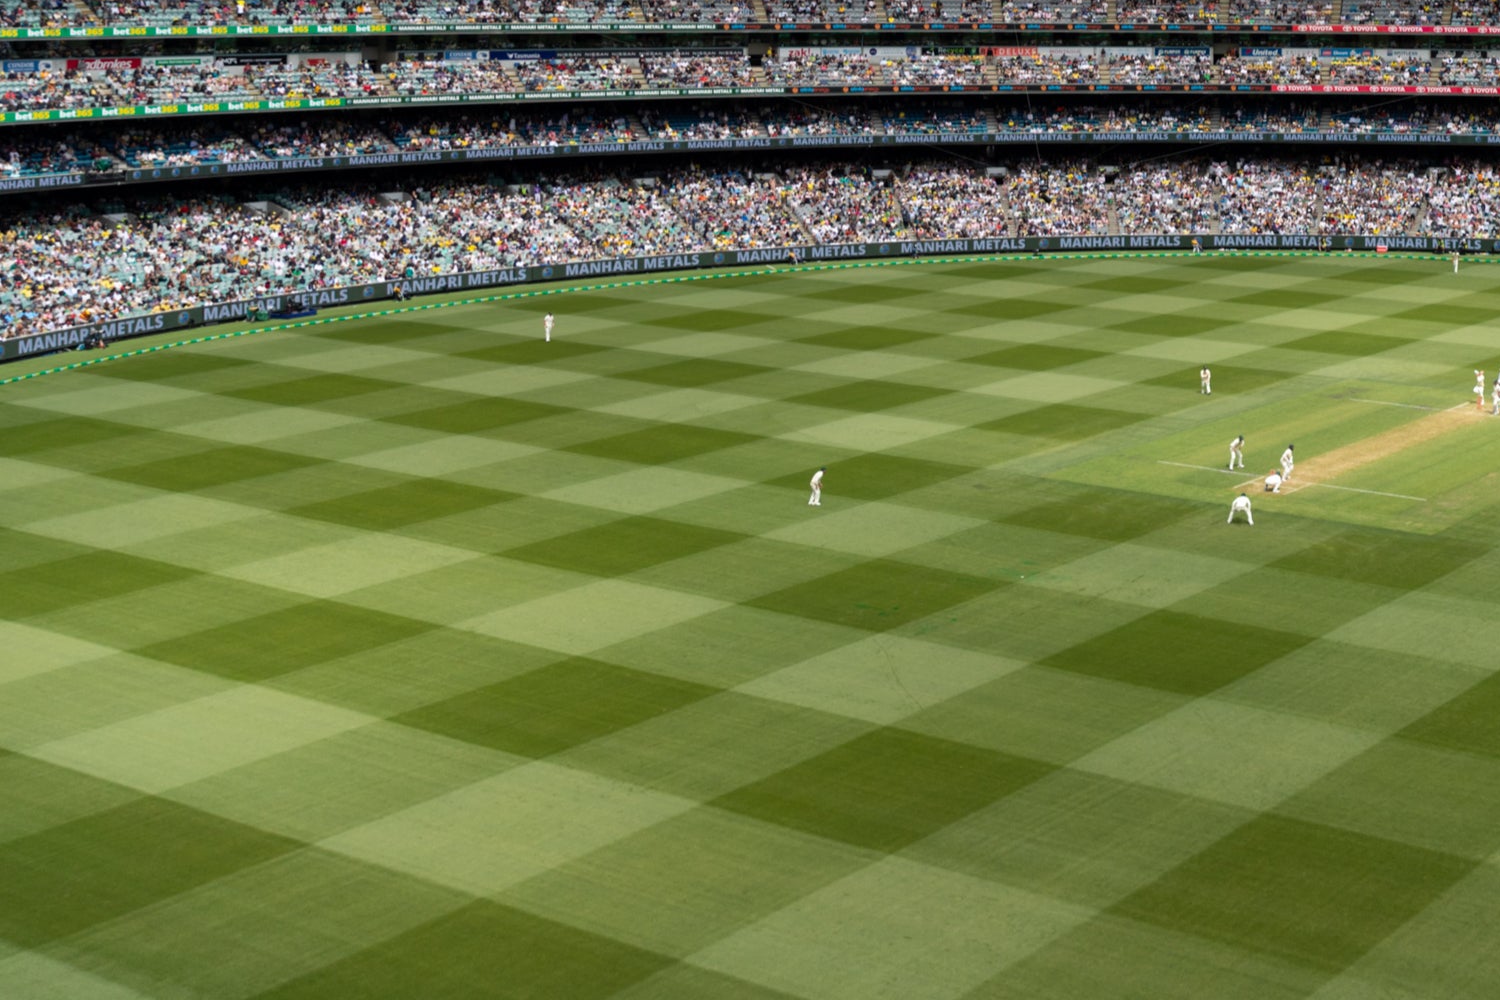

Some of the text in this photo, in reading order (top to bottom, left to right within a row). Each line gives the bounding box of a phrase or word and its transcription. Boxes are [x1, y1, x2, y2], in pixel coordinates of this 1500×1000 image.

[15, 112, 49, 120] bet365
[59, 110, 92, 118] bet365
[102, 108, 135, 116] bet365
[793, 136, 873, 145] MANHARI METALS
[896, 134, 974, 143] MANHARI METALS
[995, 133, 1072, 141] MANHARI METALS
[1093, 132, 1168, 141] MANHARI METALS
[1189, 133, 1263, 141] MANHARI METALS
[1284, 133, 1357, 141] MANHARI METALS
[1377, 134, 1450, 143] MANHARI METALS
[579, 141, 664, 153] MANHARI METALS
[688, 138, 771, 149] MANHARI METALS
[466, 147, 555, 158] MANHARI METALS
[349, 153, 441, 165] MANHARI METALS
[227, 159, 323, 172] MANHARI METALS
[0, 176, 81, 189] NHARI METALS
[901, 239, 1025, 253] MANHARI METALS
[1060, 236, 1180, 247] MANHARI METALS
[1214, 236, 1332, 246] MANHARI METALS
[1365, 237, 1482, 249] MANHARI METLS
[737, 245, 866, 262] MANHARI METALS
[566, 255, 699, 276] MANHARI METALS
[387, 270, 526, 295] MANHARI METALS
[18, 315, 164, 355] MANHAR METALS
